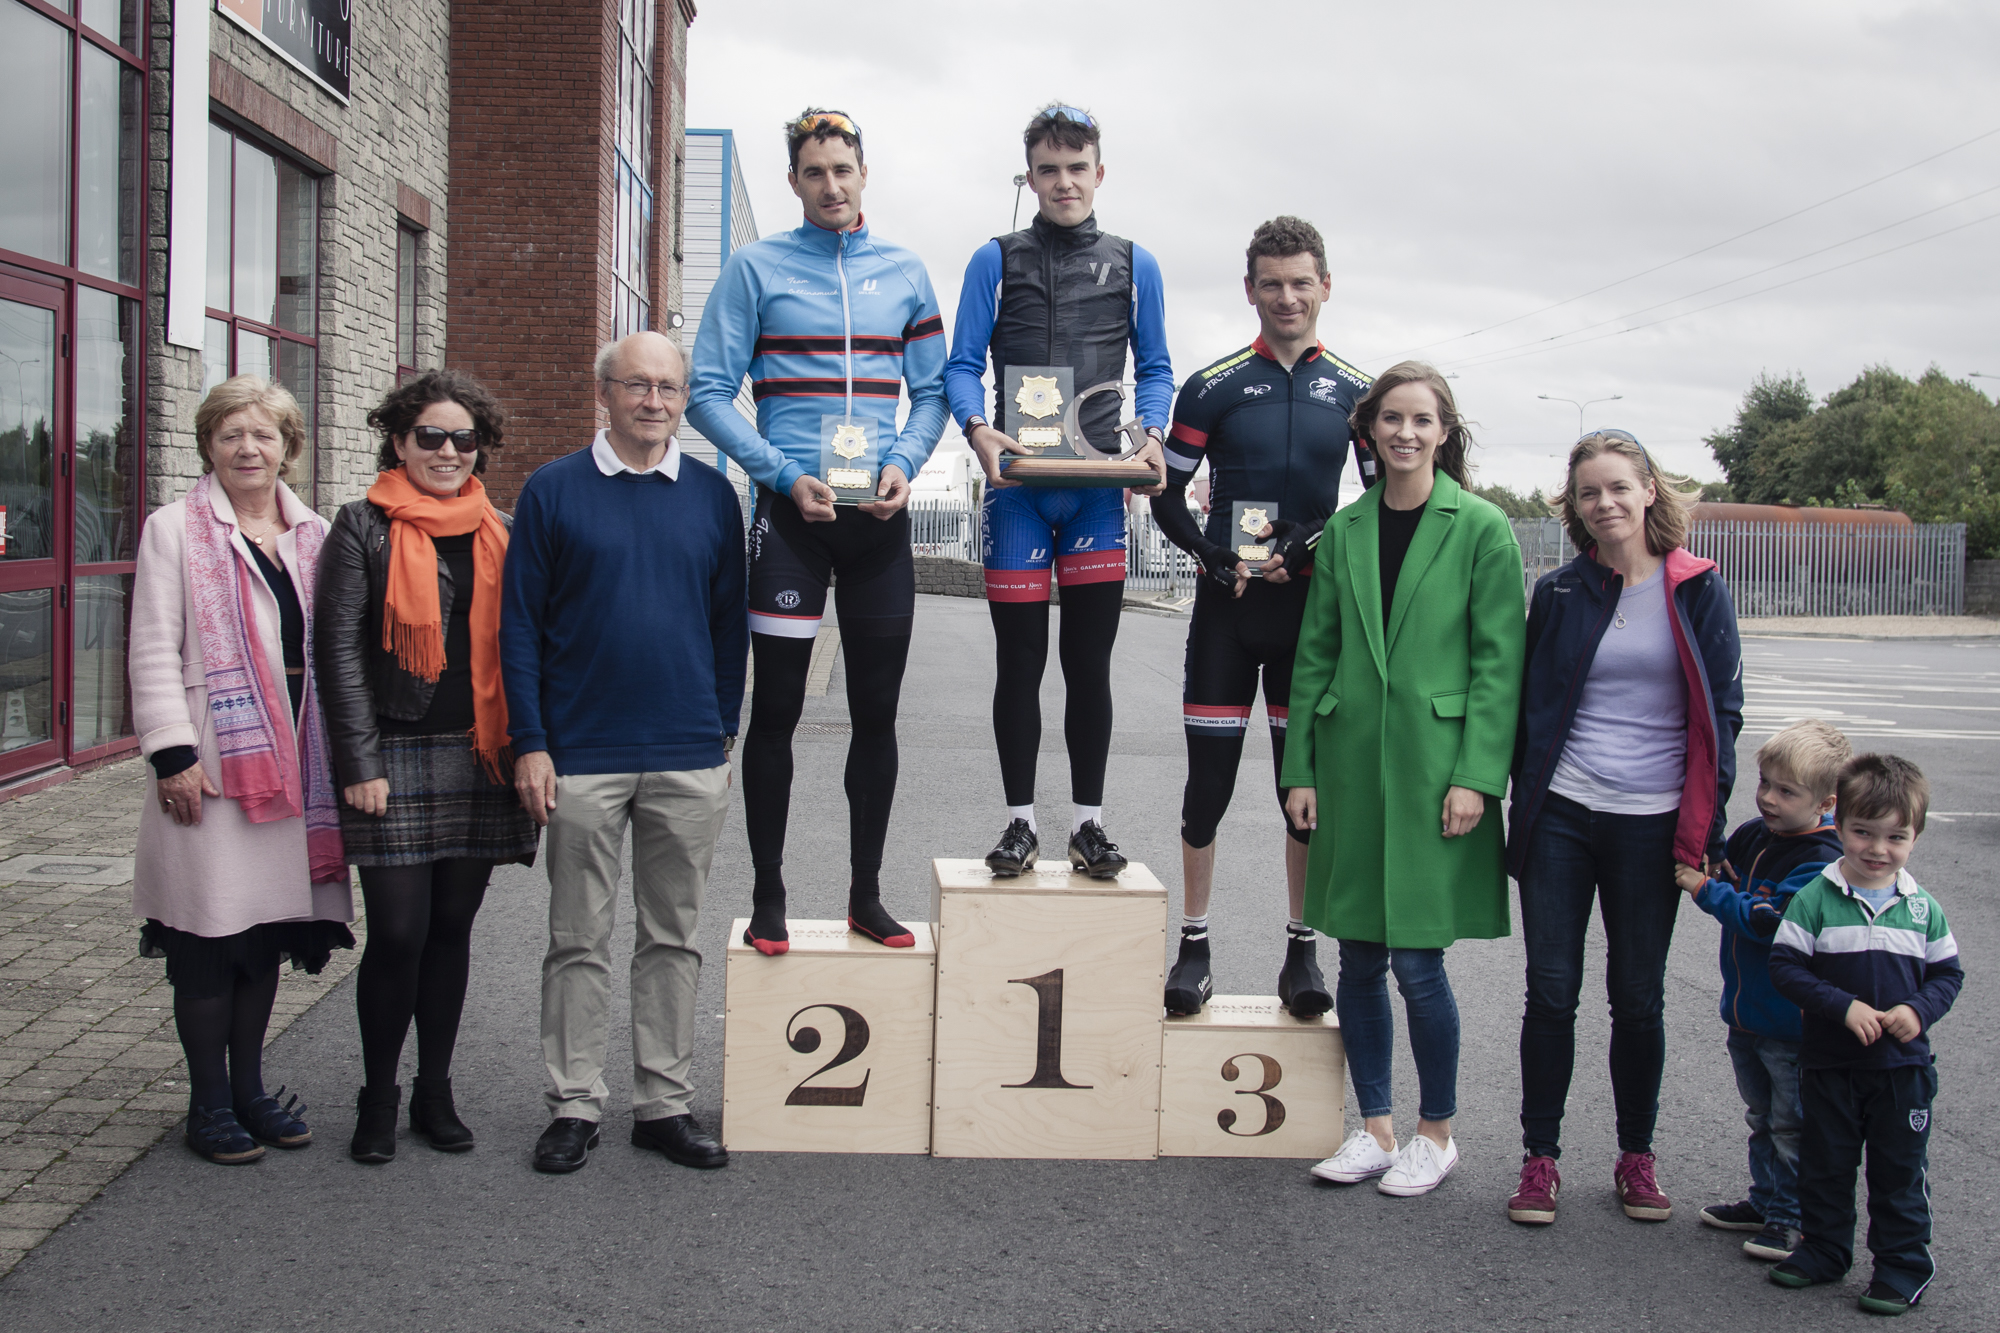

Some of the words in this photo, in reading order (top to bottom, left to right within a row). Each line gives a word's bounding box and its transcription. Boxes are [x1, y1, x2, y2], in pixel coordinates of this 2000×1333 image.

[786, 276, 810, 285] Team
[1197, 387, 1208, 400] THE
[755, 517, 769, 561] Team
[1080, 563, 1105, 571] GALWAY
[1191, 717, 1220, 725] CYCLING
[1000, 968, 1094, 1089] 1
[784, 1003, 871, 1107] 2
[1217, 1053, 1286, 1137] 3
